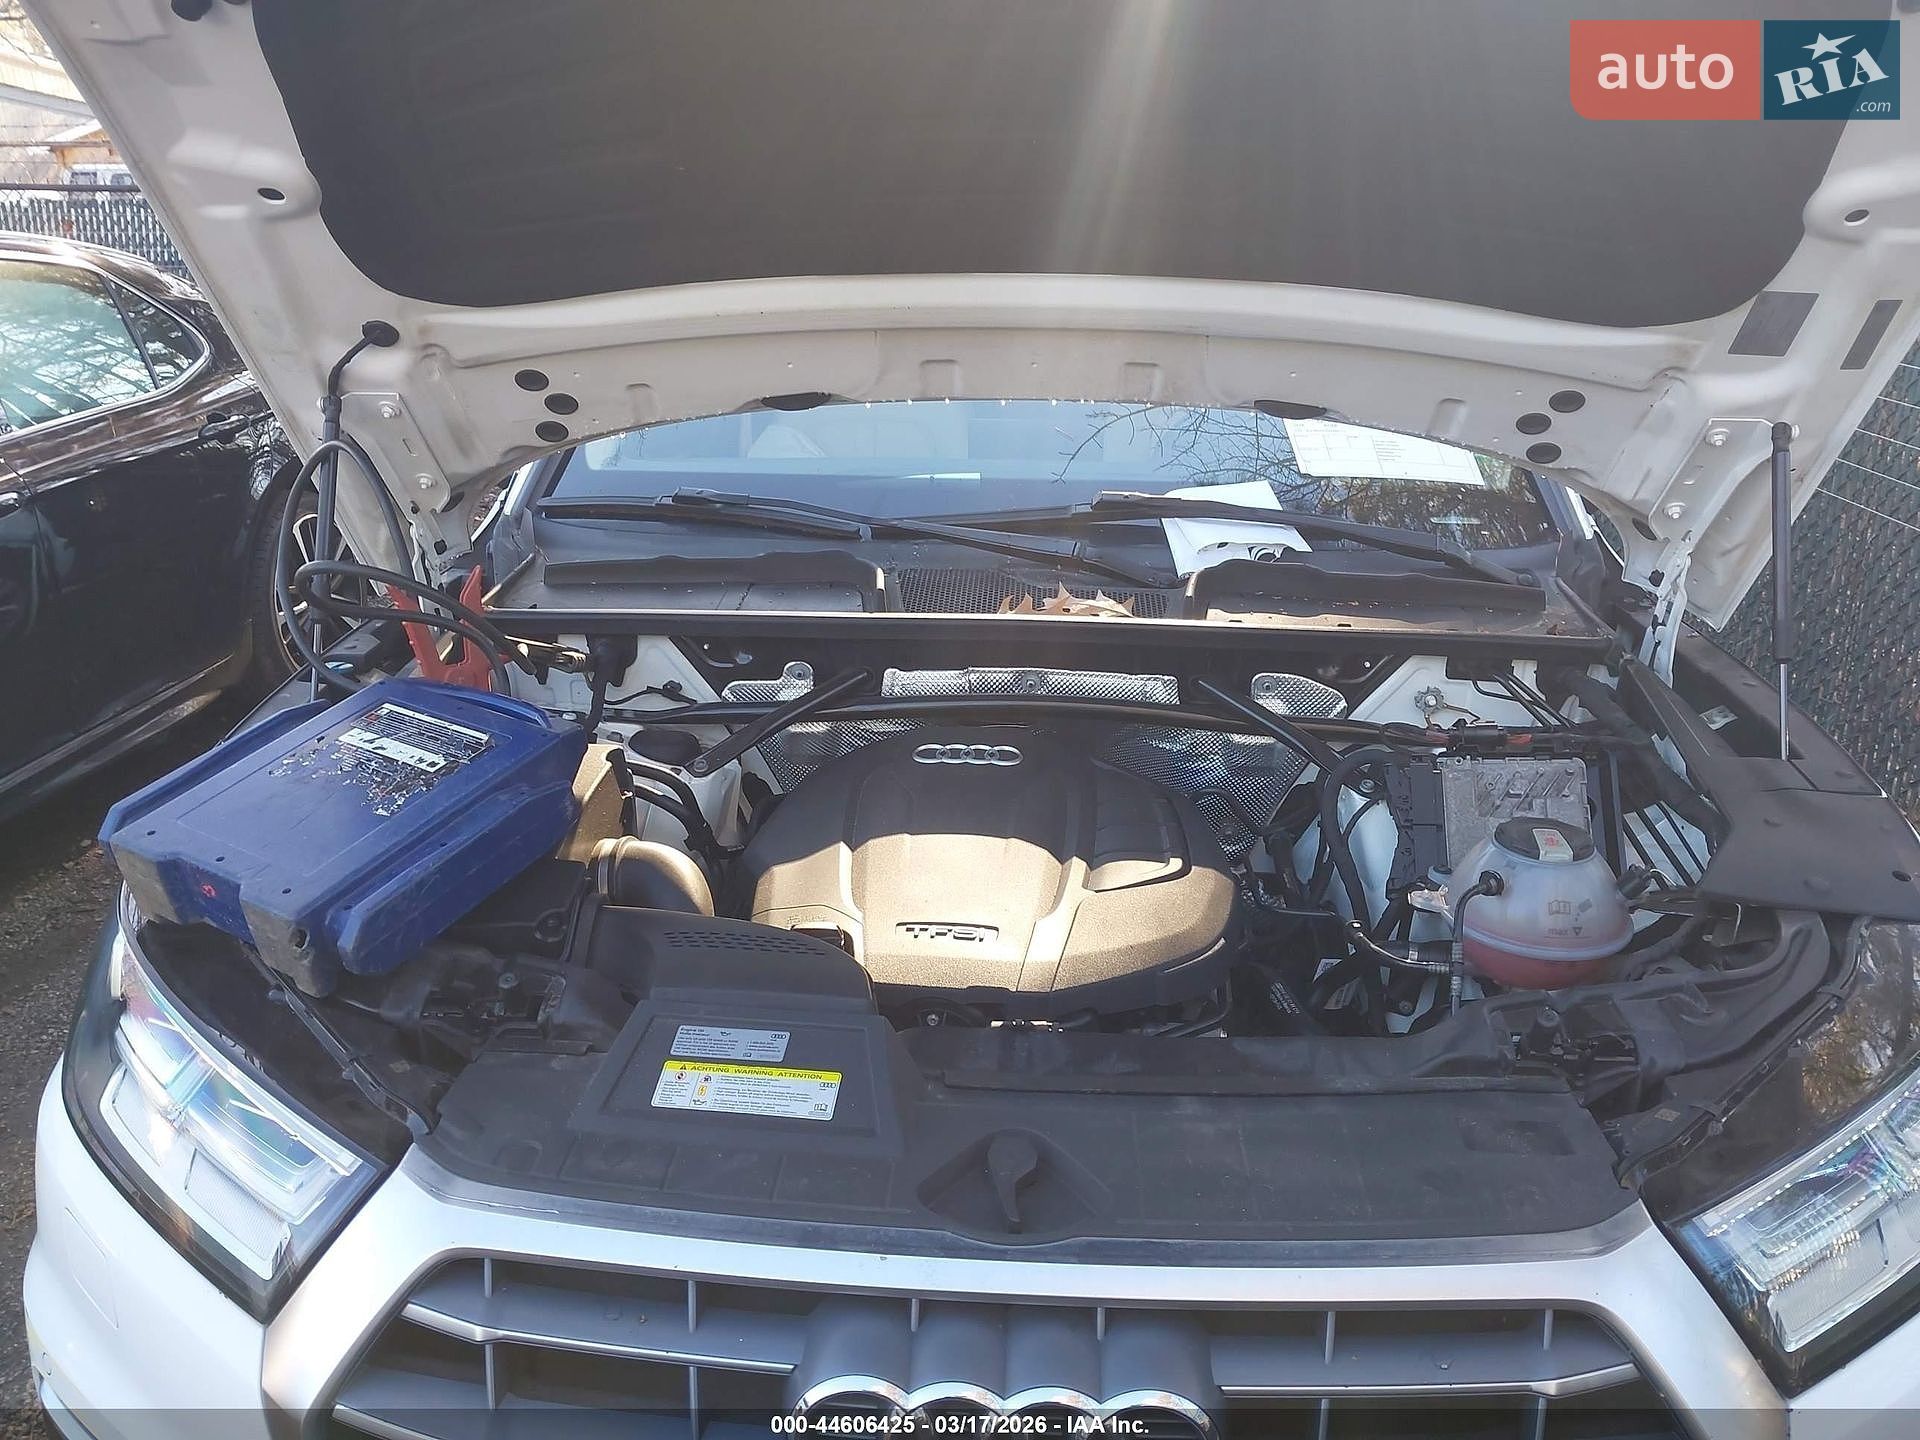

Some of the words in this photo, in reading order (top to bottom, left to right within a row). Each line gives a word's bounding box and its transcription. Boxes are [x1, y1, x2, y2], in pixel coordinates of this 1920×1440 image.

[690, 1065, 730, 1073] ACHTUNG
[734, 1068, 774, 1077] WARNING
[777, 1071, 823, 1080] ATTENTION
